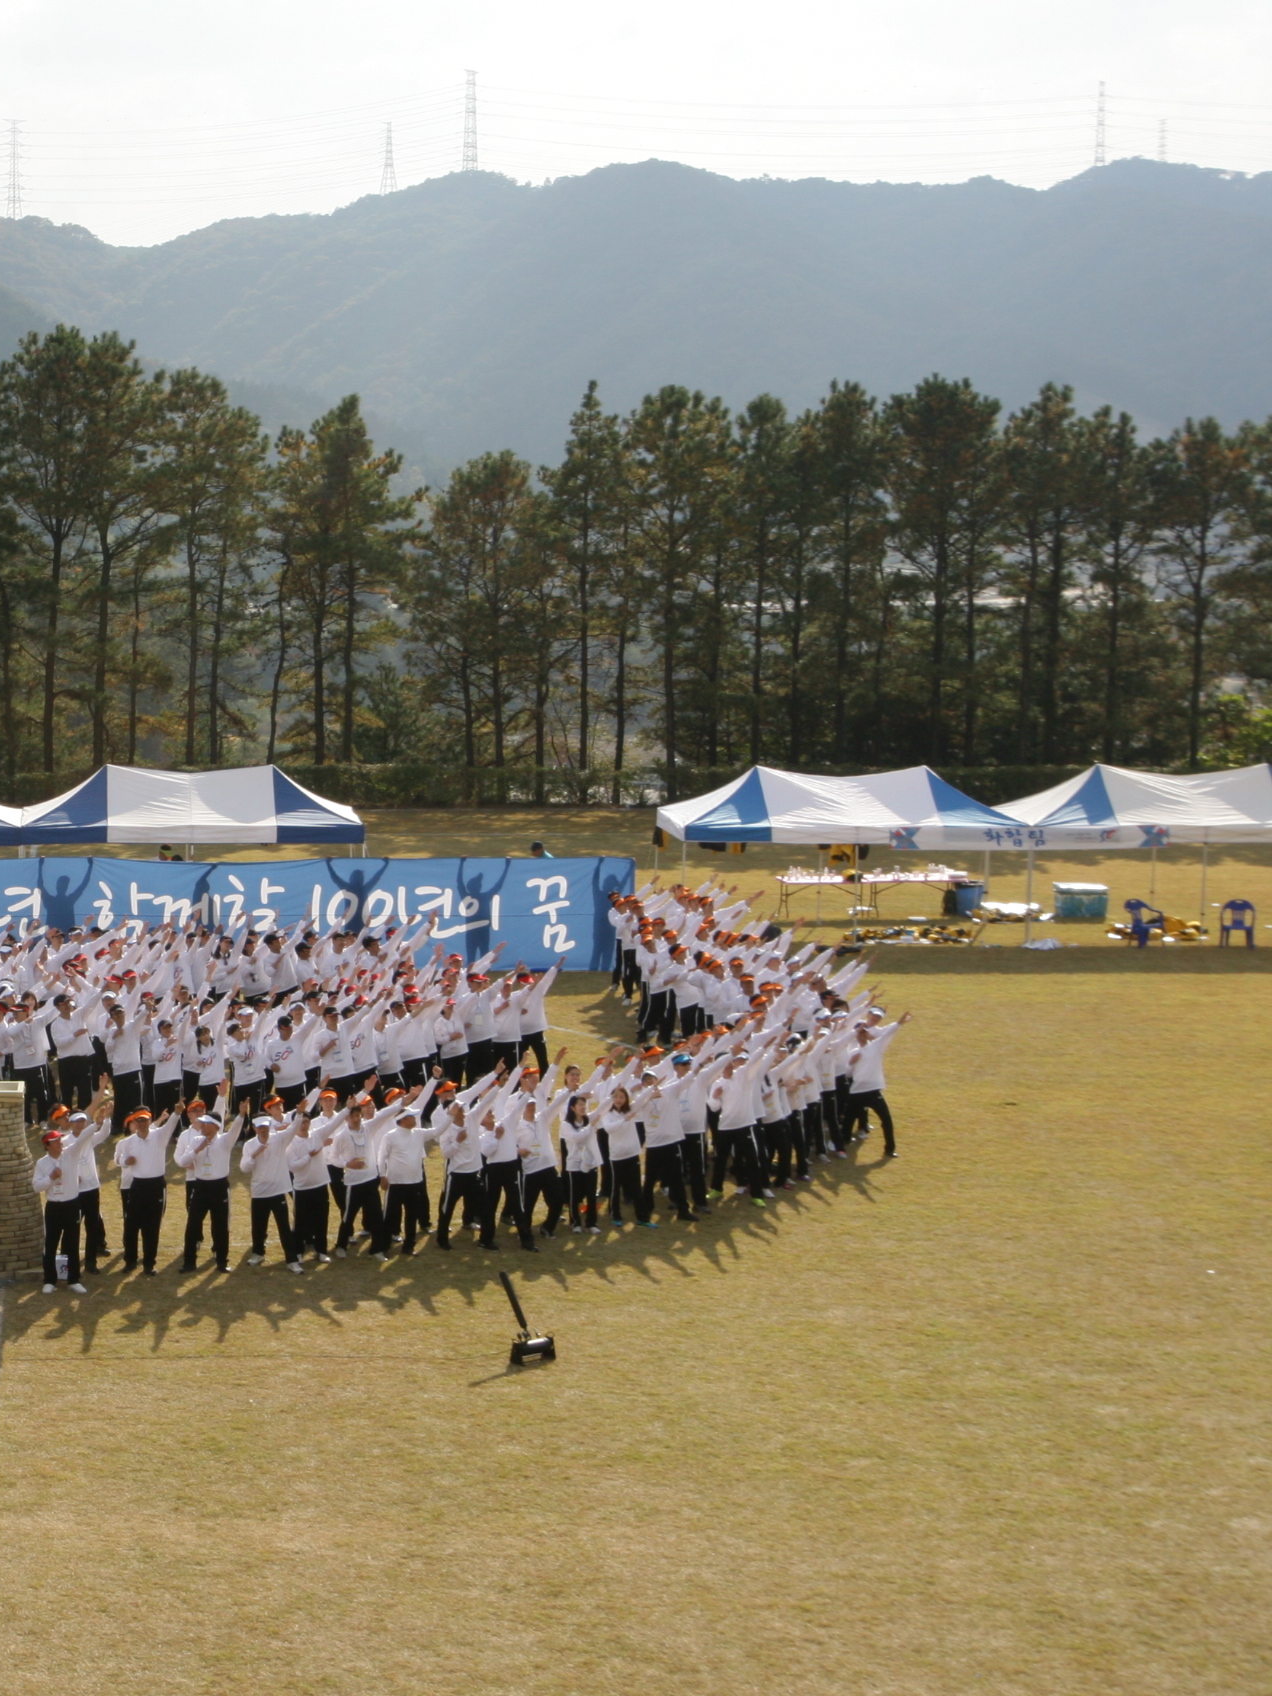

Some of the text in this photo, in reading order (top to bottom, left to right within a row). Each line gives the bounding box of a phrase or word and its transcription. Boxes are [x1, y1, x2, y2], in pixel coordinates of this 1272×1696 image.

[983, 828, 1046, 847] 화합팀
[93, 874, 286, 939] 함께할
[311, 883, 501, 940] 100년의
[526, 875, 576, 953] 꿈
